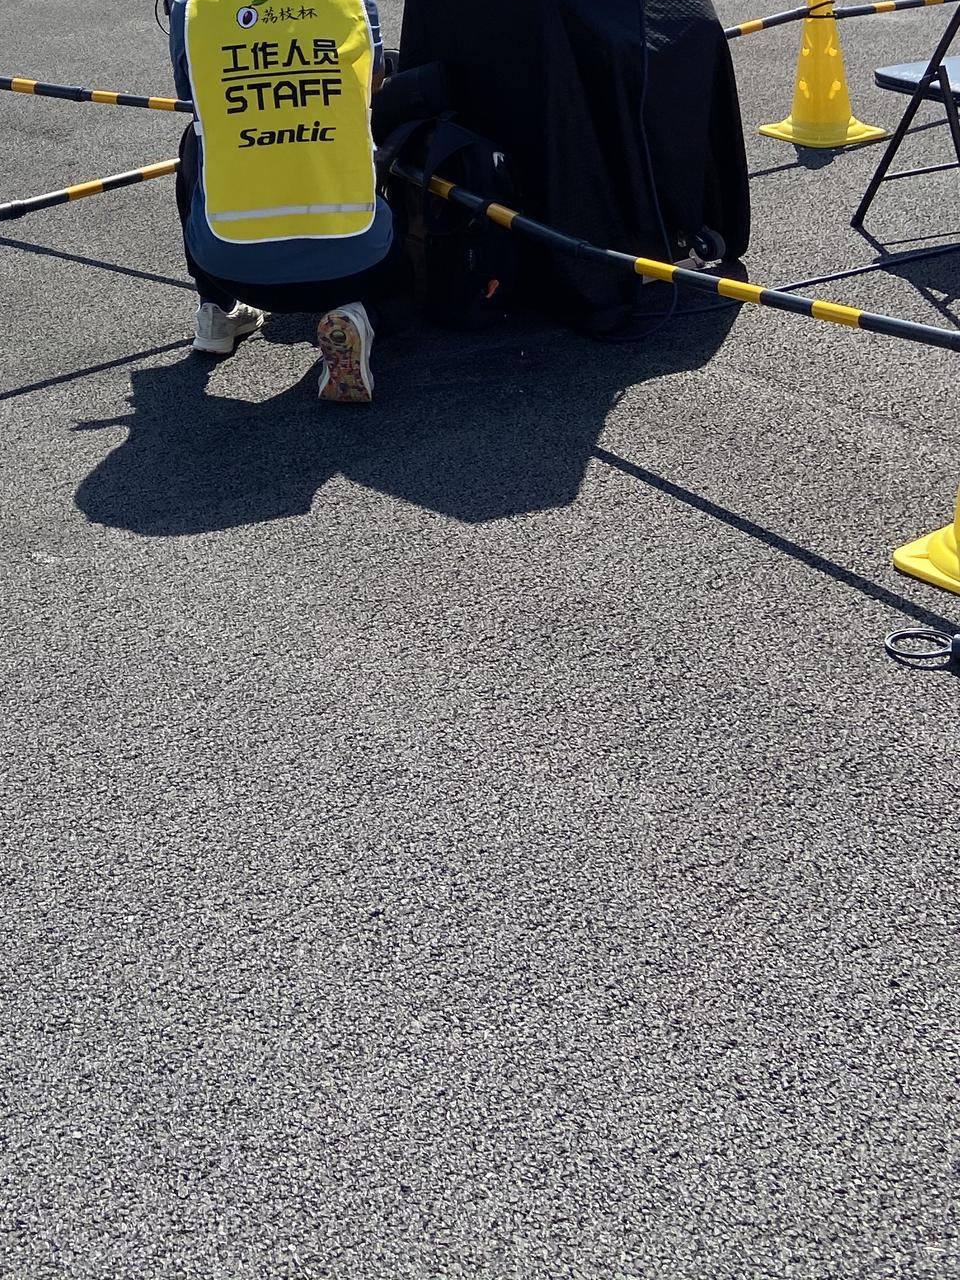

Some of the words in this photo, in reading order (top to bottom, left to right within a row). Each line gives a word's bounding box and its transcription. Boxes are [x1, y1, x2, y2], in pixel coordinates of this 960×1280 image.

[261, 6, 318, 24] 荔枝杯
[221, 39, 339, 73] 工作人员
[225, 78, 342, 114] STAFF
[238, 120, 336, 148] Santic
